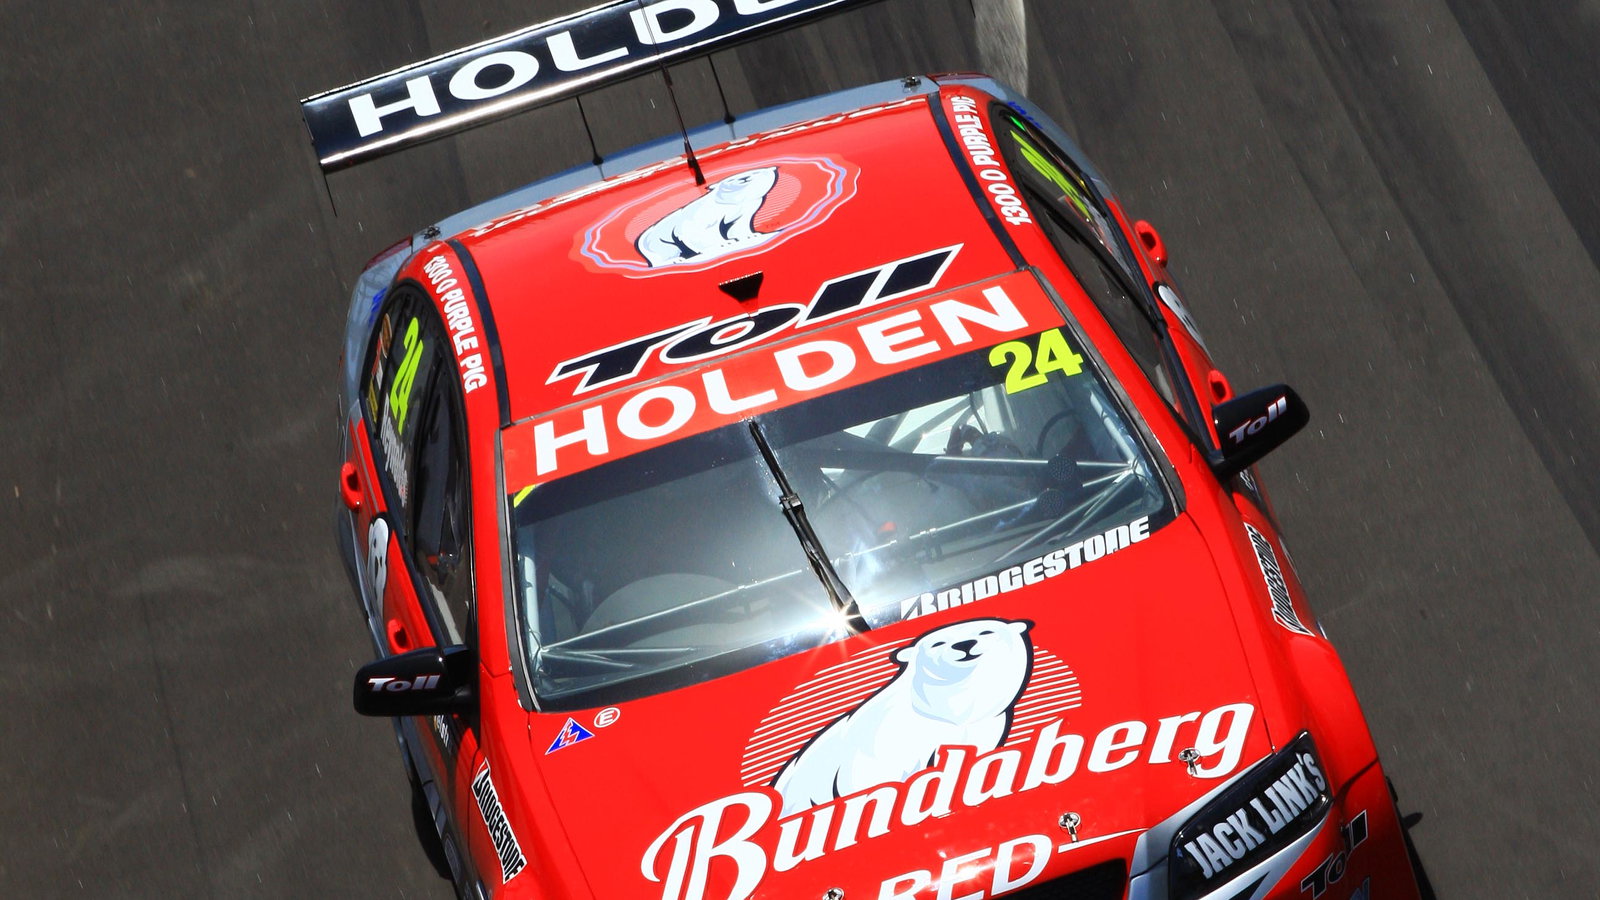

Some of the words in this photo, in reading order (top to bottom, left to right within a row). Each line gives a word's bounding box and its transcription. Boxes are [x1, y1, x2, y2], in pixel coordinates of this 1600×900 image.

[347, 0, 800, 138] HOLD
[950, 95, 977, 117] PIG
[953, 110, 1000, 166] PURPLE
[988, 184, 1032, 226] 1300
[389, 316, 424, 435] 24
[424, 255, 455, 286] 1300
[440, 288, 479, 356] PURPLE
[460, 353, 488, 394] PIG
[545, 243, 964, 396] Toll
[989, 328, 1084, 395] 24
[534, 285, 1030, 477] HOLDEN
[1229, 396, 1287, 444] Toll
[900, 515, 1151, 621] BRIDGESTONE
[368, 674, 441, 692] Toll
[471, 757, 528, 885] BRIDGESTONE
[640, 703, 1255, 900] Bundaberg
[1184, 808, 1267, 880] JACK
[1250, 752, 1327, 836] LINK'S
